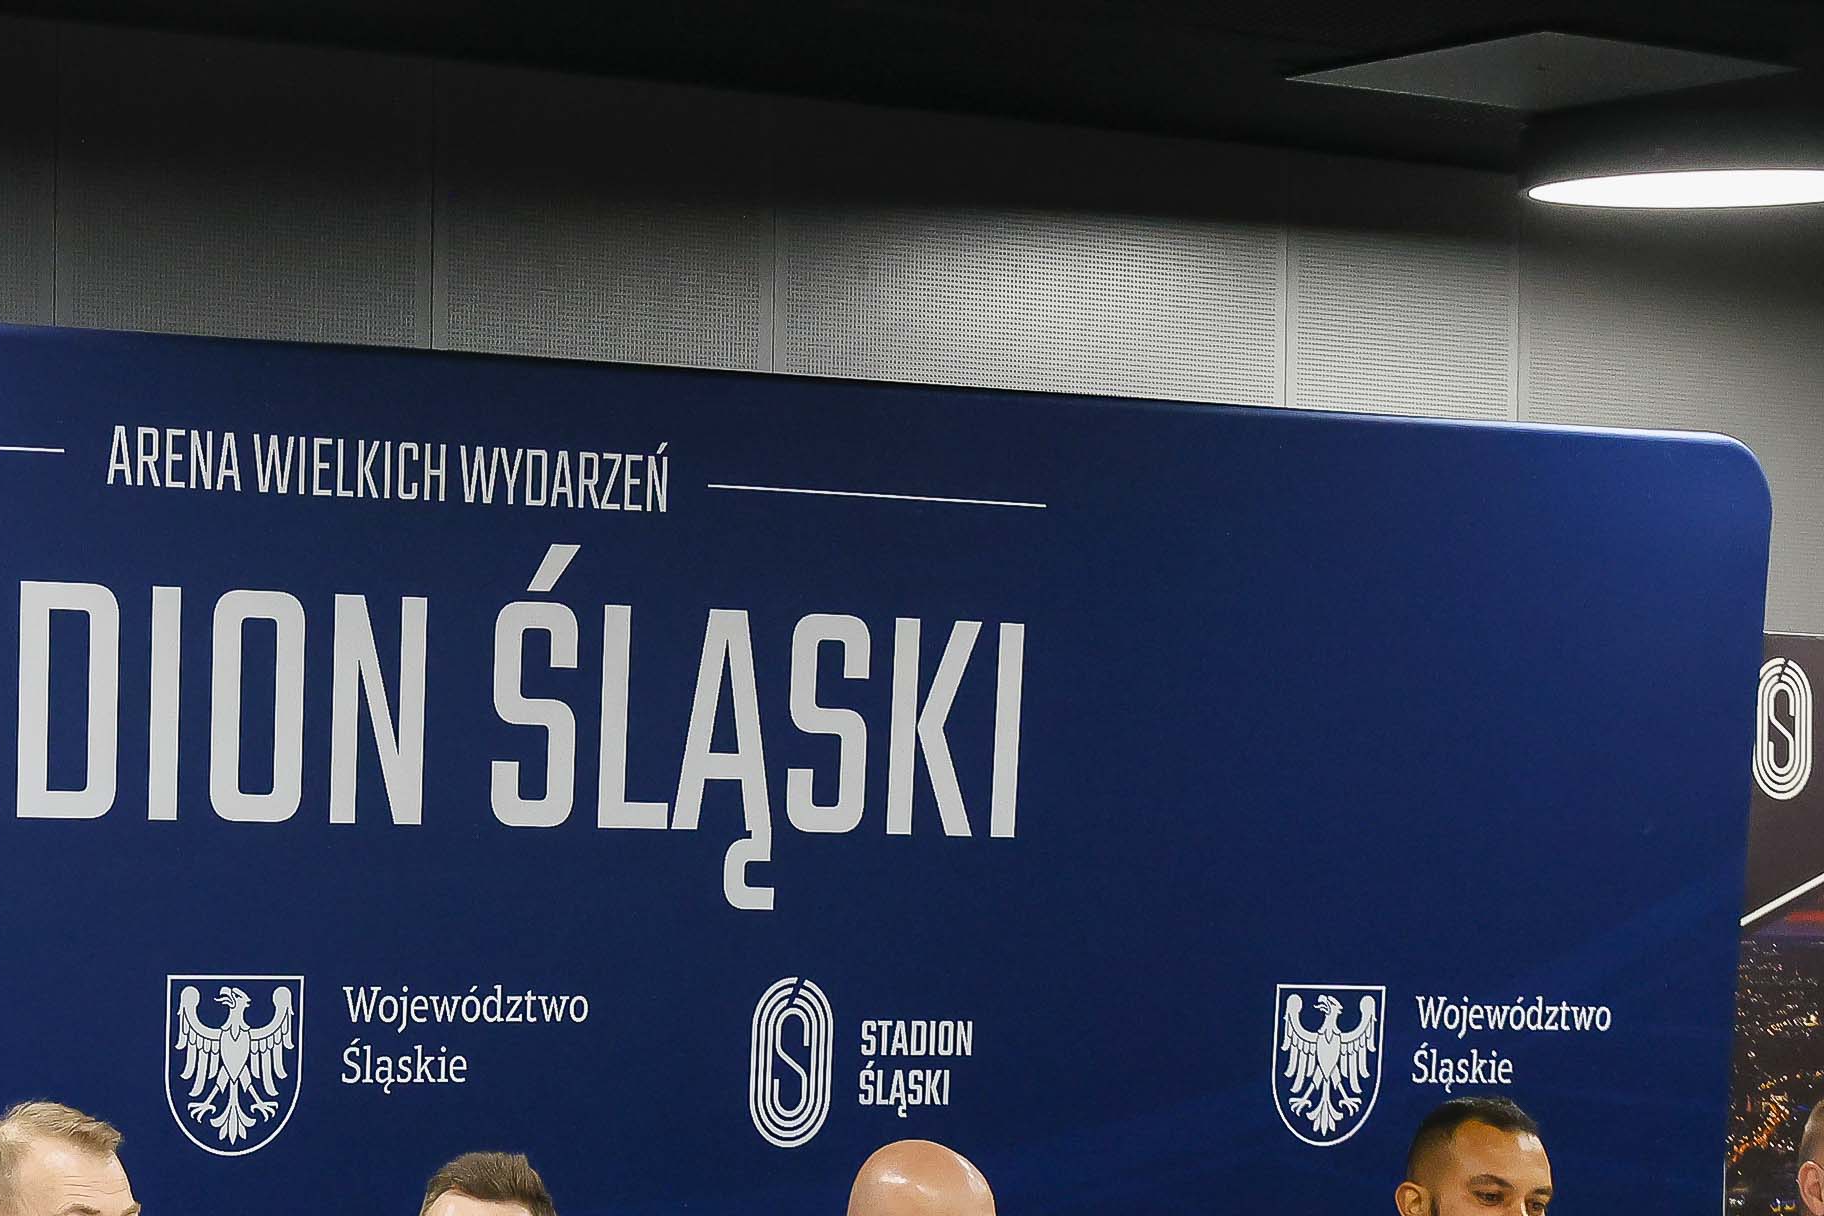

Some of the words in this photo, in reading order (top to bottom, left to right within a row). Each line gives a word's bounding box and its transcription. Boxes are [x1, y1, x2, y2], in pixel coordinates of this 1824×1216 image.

[106, 425, 242, 492] ARENA
[253, 433, 447, 502] WIELKICH
[459, 440, 669, 513] WYDARZEŃ
[489, 543, 1026, 911] ŚLĄSKI
[342, 984, 589, 1034] Województwo
[1415, 995, 1612, 1039] Województwo
[861, 1019, 973, 1056] STADION
[341, 1037, 468, 1095] Śląskie
[858, 1060, 950, 1118] ŚLĄSKI
[1411, 1041, 1514, 1094] Śląskie
